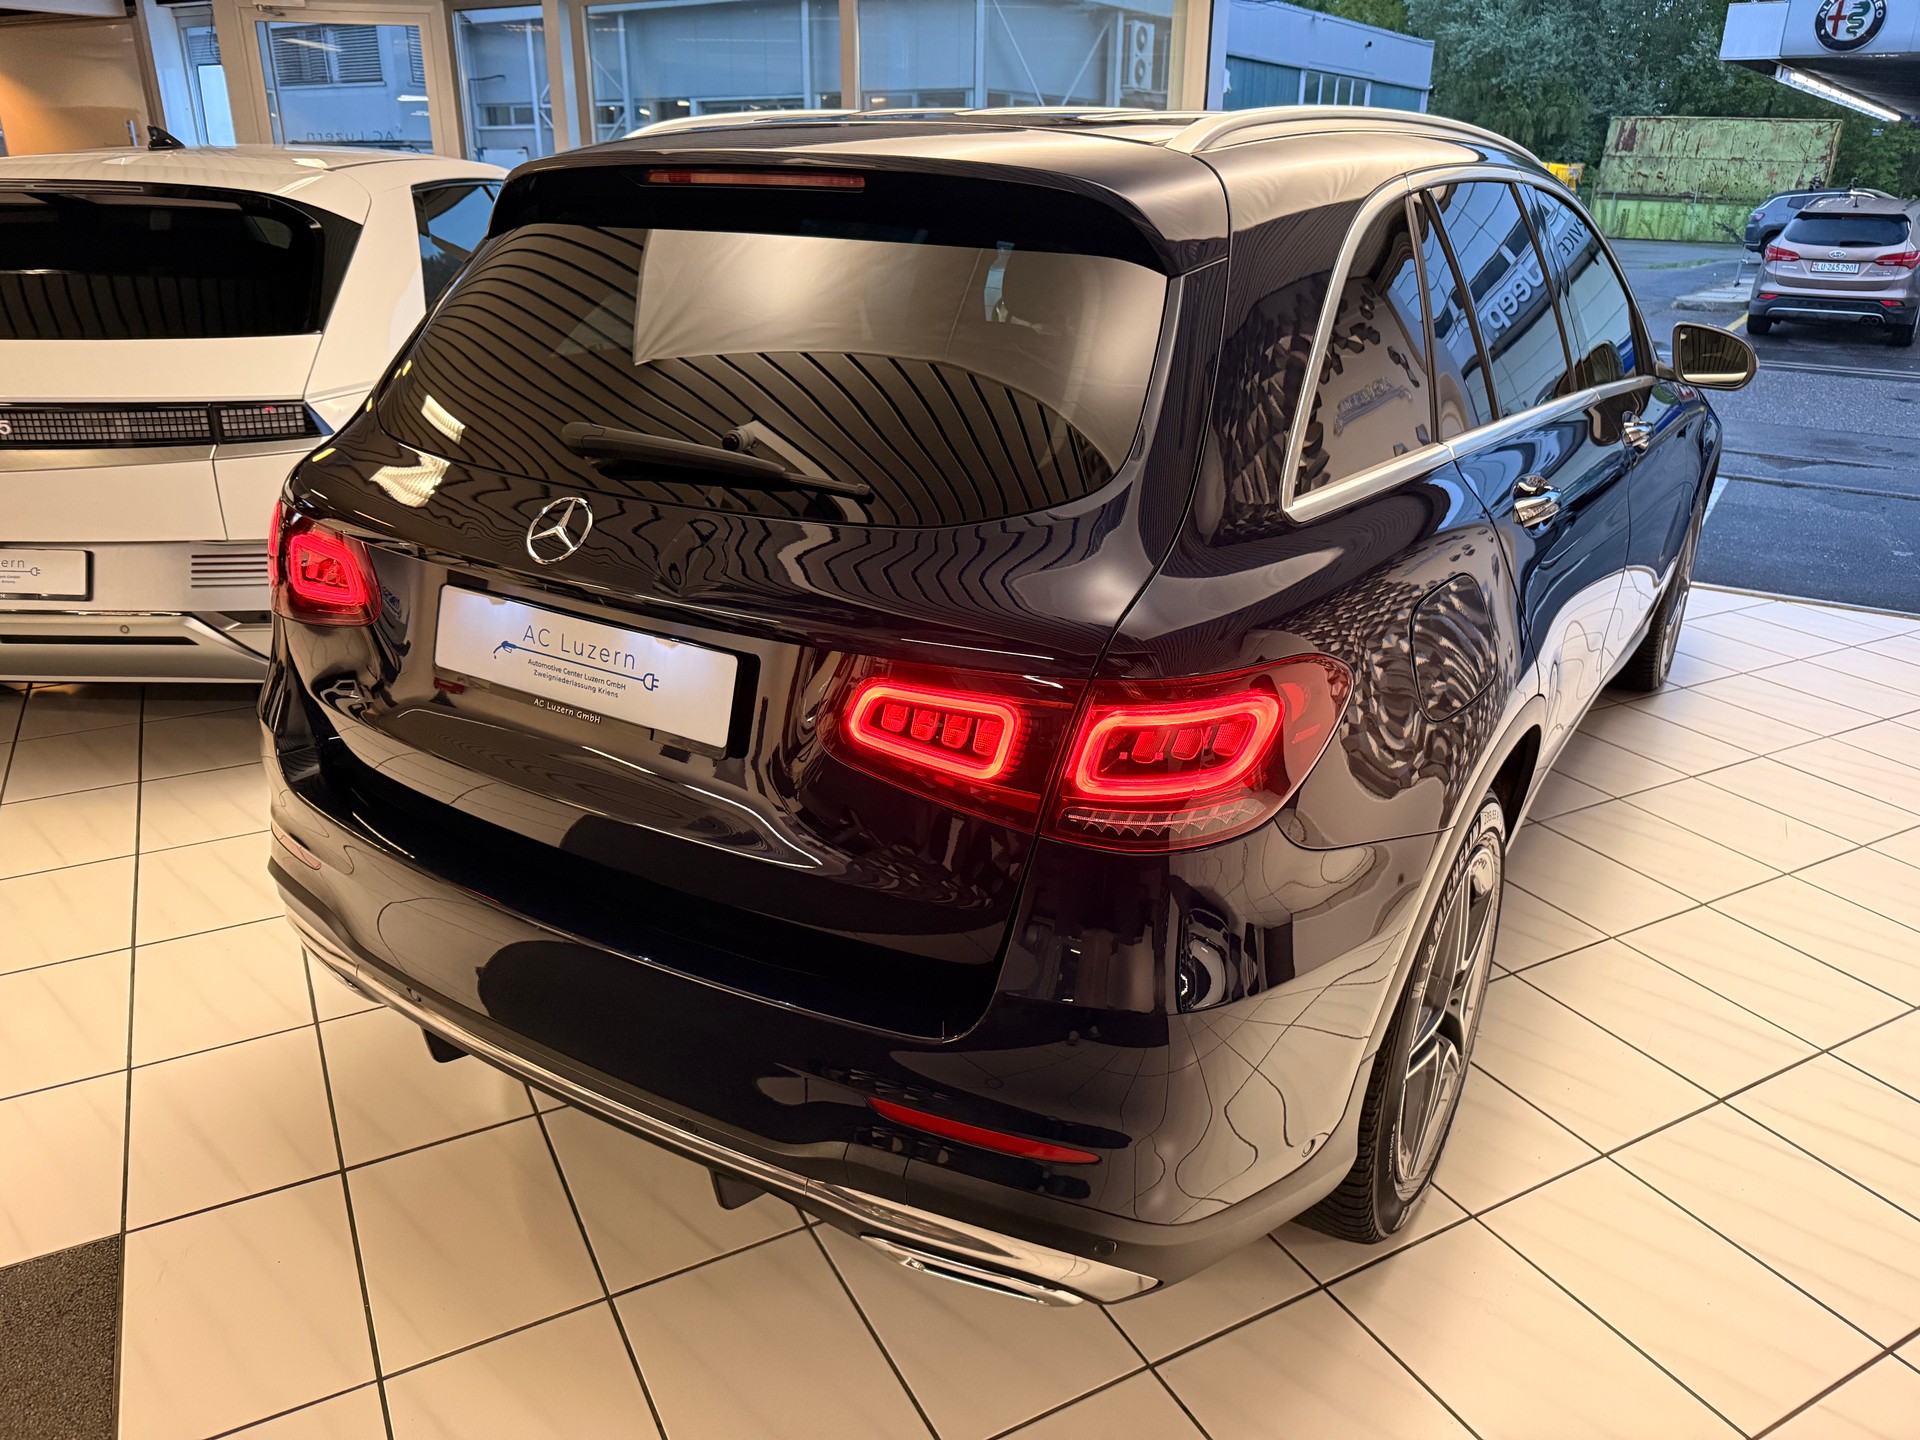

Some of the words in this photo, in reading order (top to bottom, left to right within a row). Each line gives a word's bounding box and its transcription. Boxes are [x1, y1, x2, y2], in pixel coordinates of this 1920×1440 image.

[522, 624, 551, 648] AC
[560, 633, 636, 670] Luzern
[527, 658, 562, 673] Automotive
[562, 667, 583, 679] Center
[584, 671, 605, 685] Luzern
[606, 677, 626, 691] GmbH
[533, 669, 597, 694] Zweigniederlassung
[597, 686, 619, 699] Kriens
[533, 698, 546, 708] AC
[546, 701, 574, 716] Luzern
[576, 710, 601, 724] GmbH
[1433, 821, 1480, 941] MICHELIN
